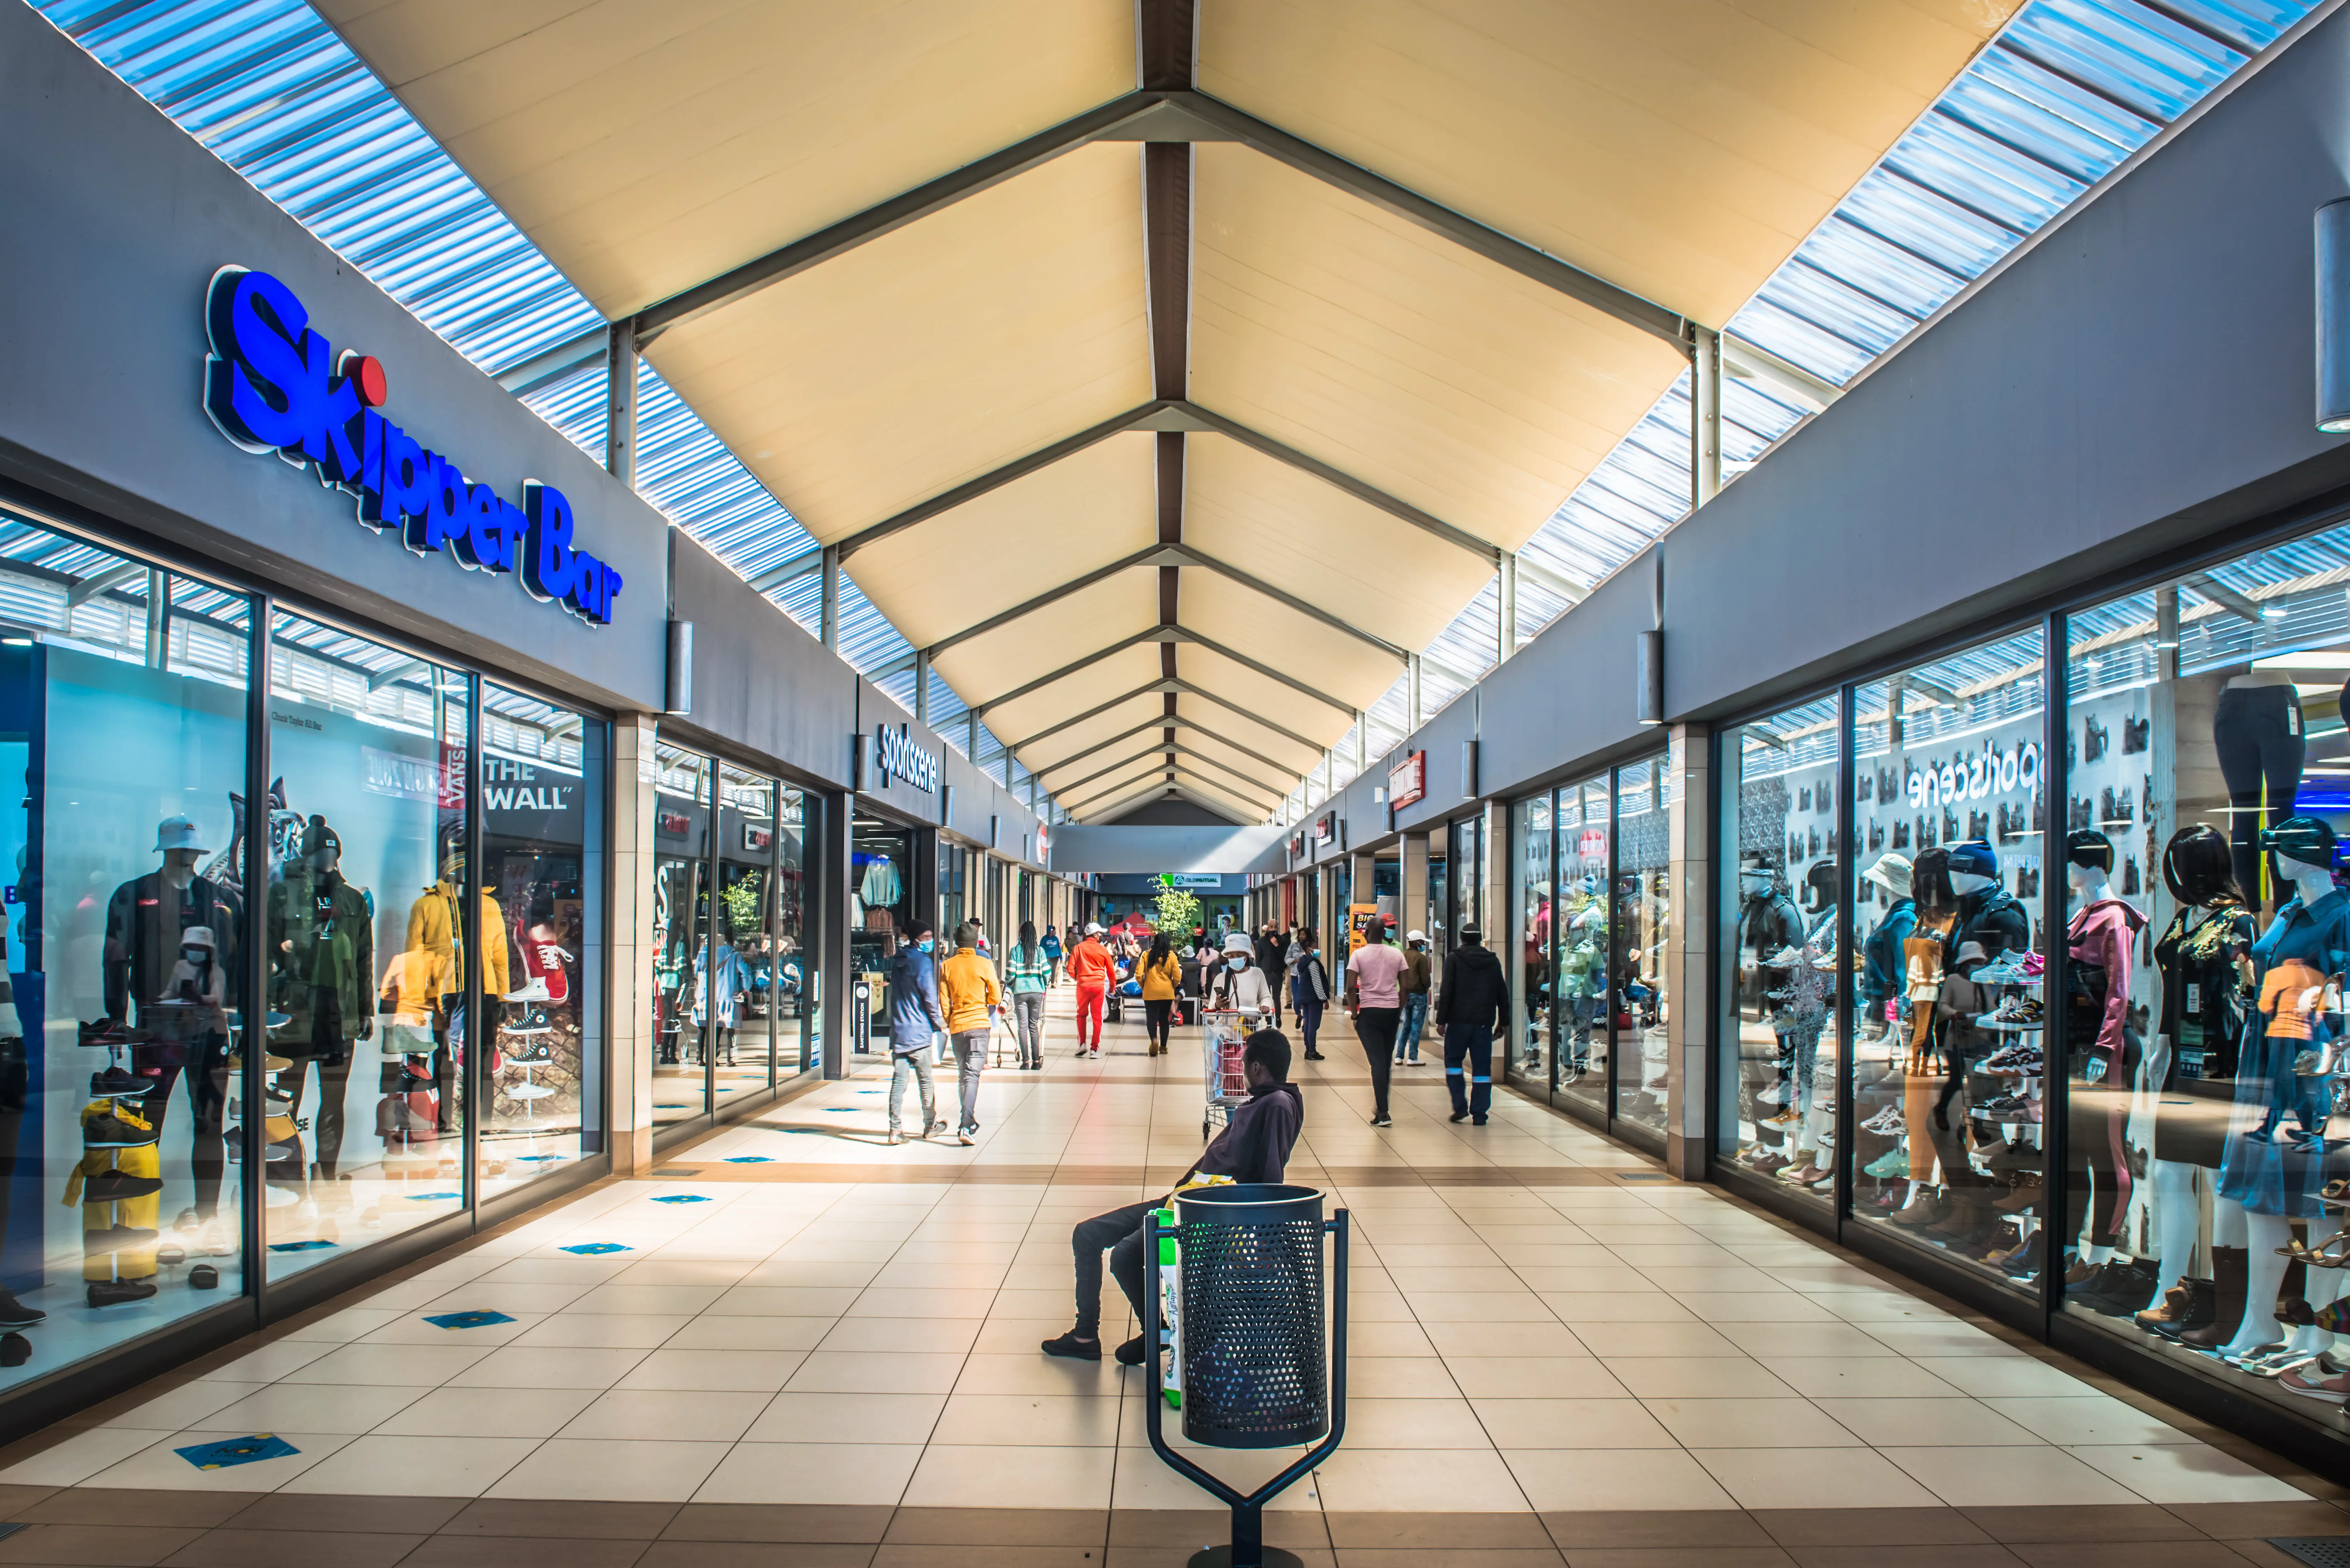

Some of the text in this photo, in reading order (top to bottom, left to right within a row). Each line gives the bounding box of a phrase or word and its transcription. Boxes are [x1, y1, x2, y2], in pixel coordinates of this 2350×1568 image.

[221, 268, 623, 625] Skipper Bar
[271, 711, 288, 723] Chuck
[289, 715, 304, 727] Taylor
[485, 760, 535, 781] THE
[880, 723, 937, 794] sportscene
